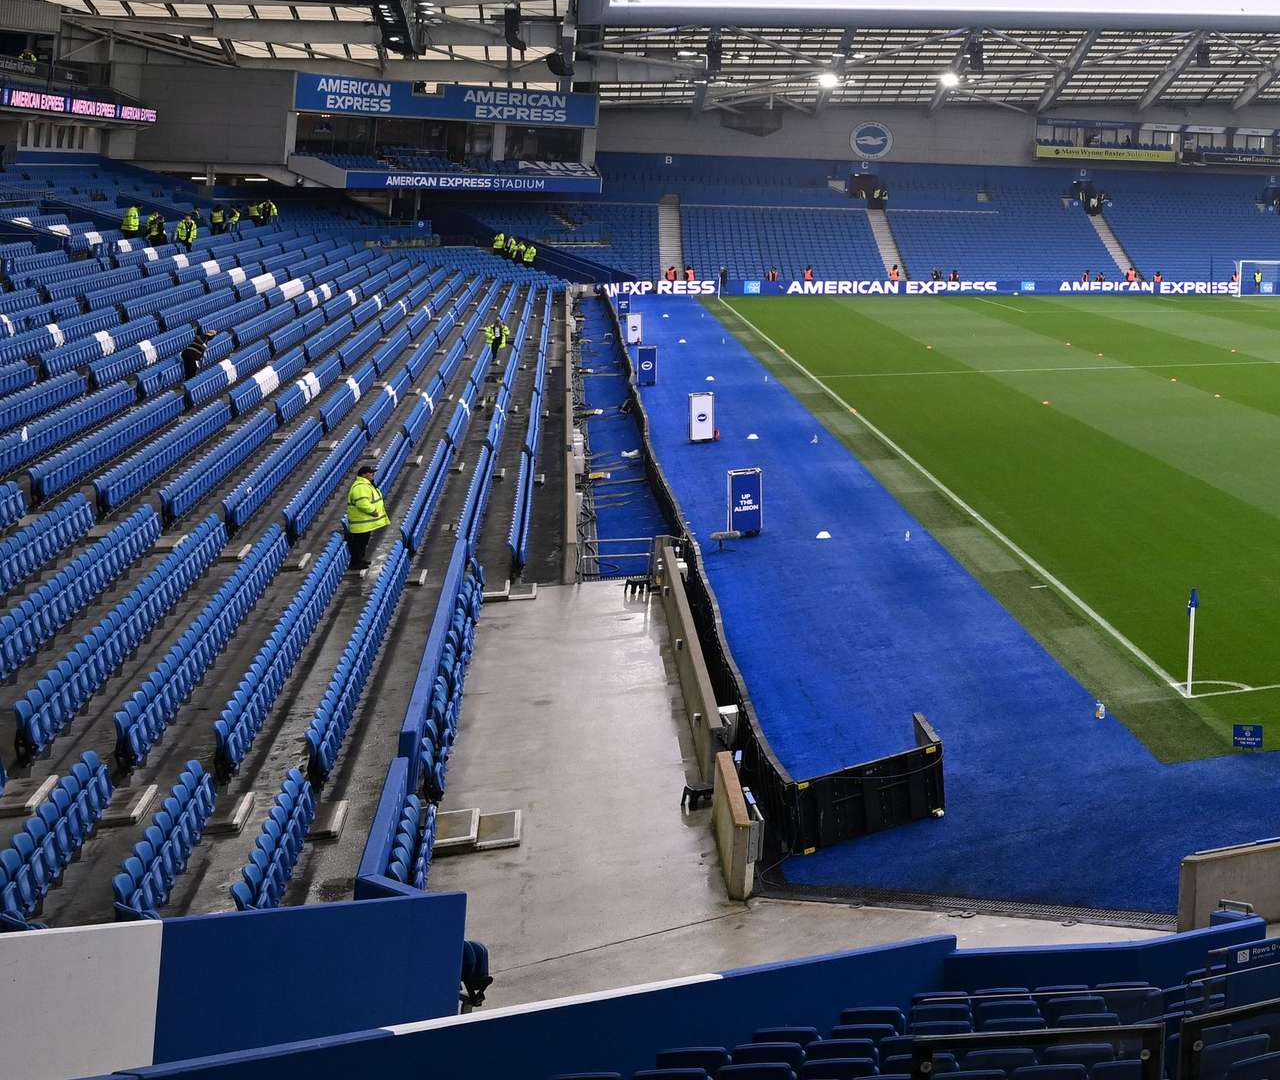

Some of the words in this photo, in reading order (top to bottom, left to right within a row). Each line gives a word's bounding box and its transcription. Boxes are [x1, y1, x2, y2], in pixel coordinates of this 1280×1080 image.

[317, 78, 391, 97] AMERICAN
[10, 90, 40, 109] AMERICAN
[41, 94, 64, 112] EXPRESS
[327, 95, 391, 112] EXPRESS
[464, 90, 566, 108] AMERICAN
[72, 99, 96, 116] AMERICAN
[96, 102, 115, 117] EXPRESS
[121, 106, 141, 120] AMERICAN
[141, 108, 157, 122] EXPRESS
[475, 105, 567, 122] EXPRESS
[665, 156, 672, 164] B
[861, 161, 869, 169] C
[386, 176, 438, 187] AMERICAN
[439, 177, 491, 188] EXPRESS
[493, 178, 545, 189] STADIUM
[787, 280, 899, 294] AMERICAN
[906, 281, 997, 294] EXPRESS
[1059, 281, 1153, 293] AMERICAN
[1160, 282, 1239, 294] EXPRESS
[1253, 946, 1270, 955] Rows
